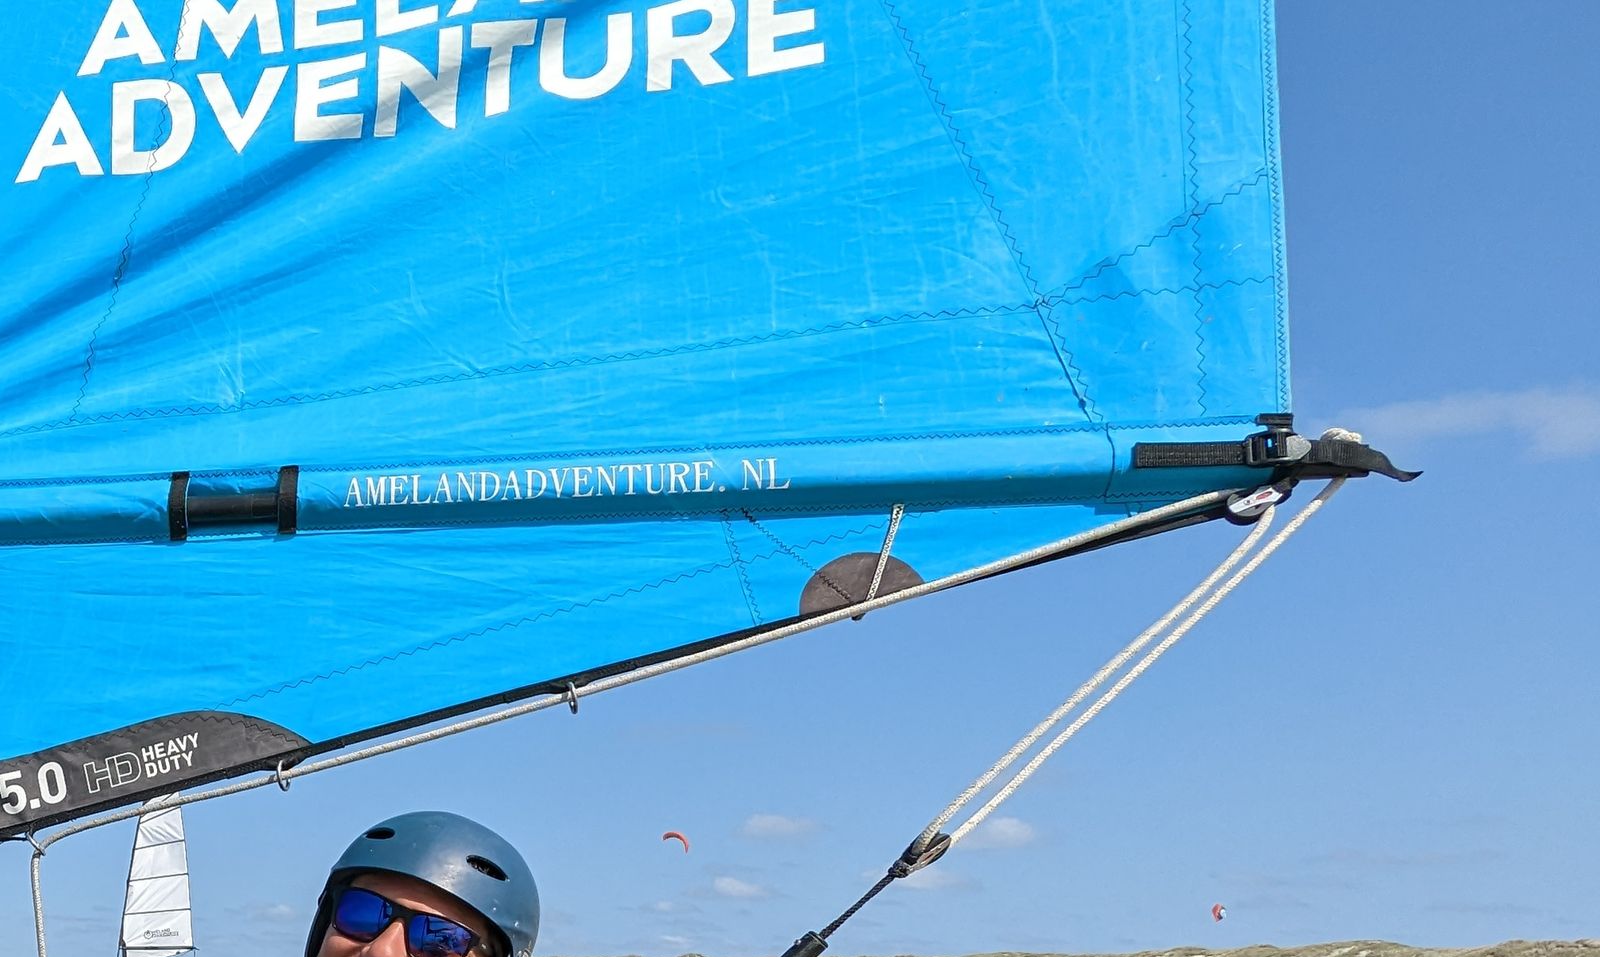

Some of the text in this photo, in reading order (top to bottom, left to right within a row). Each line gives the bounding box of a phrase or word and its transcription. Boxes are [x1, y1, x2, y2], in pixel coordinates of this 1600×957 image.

[15, 0, 825, 183] ADVENTURE
[741, 458, 790, 490] NL
[141, 732, 199, 762] HEAVY
[83, 751, 142, 793] HD
[144, 750, 193, 778] DUTY
